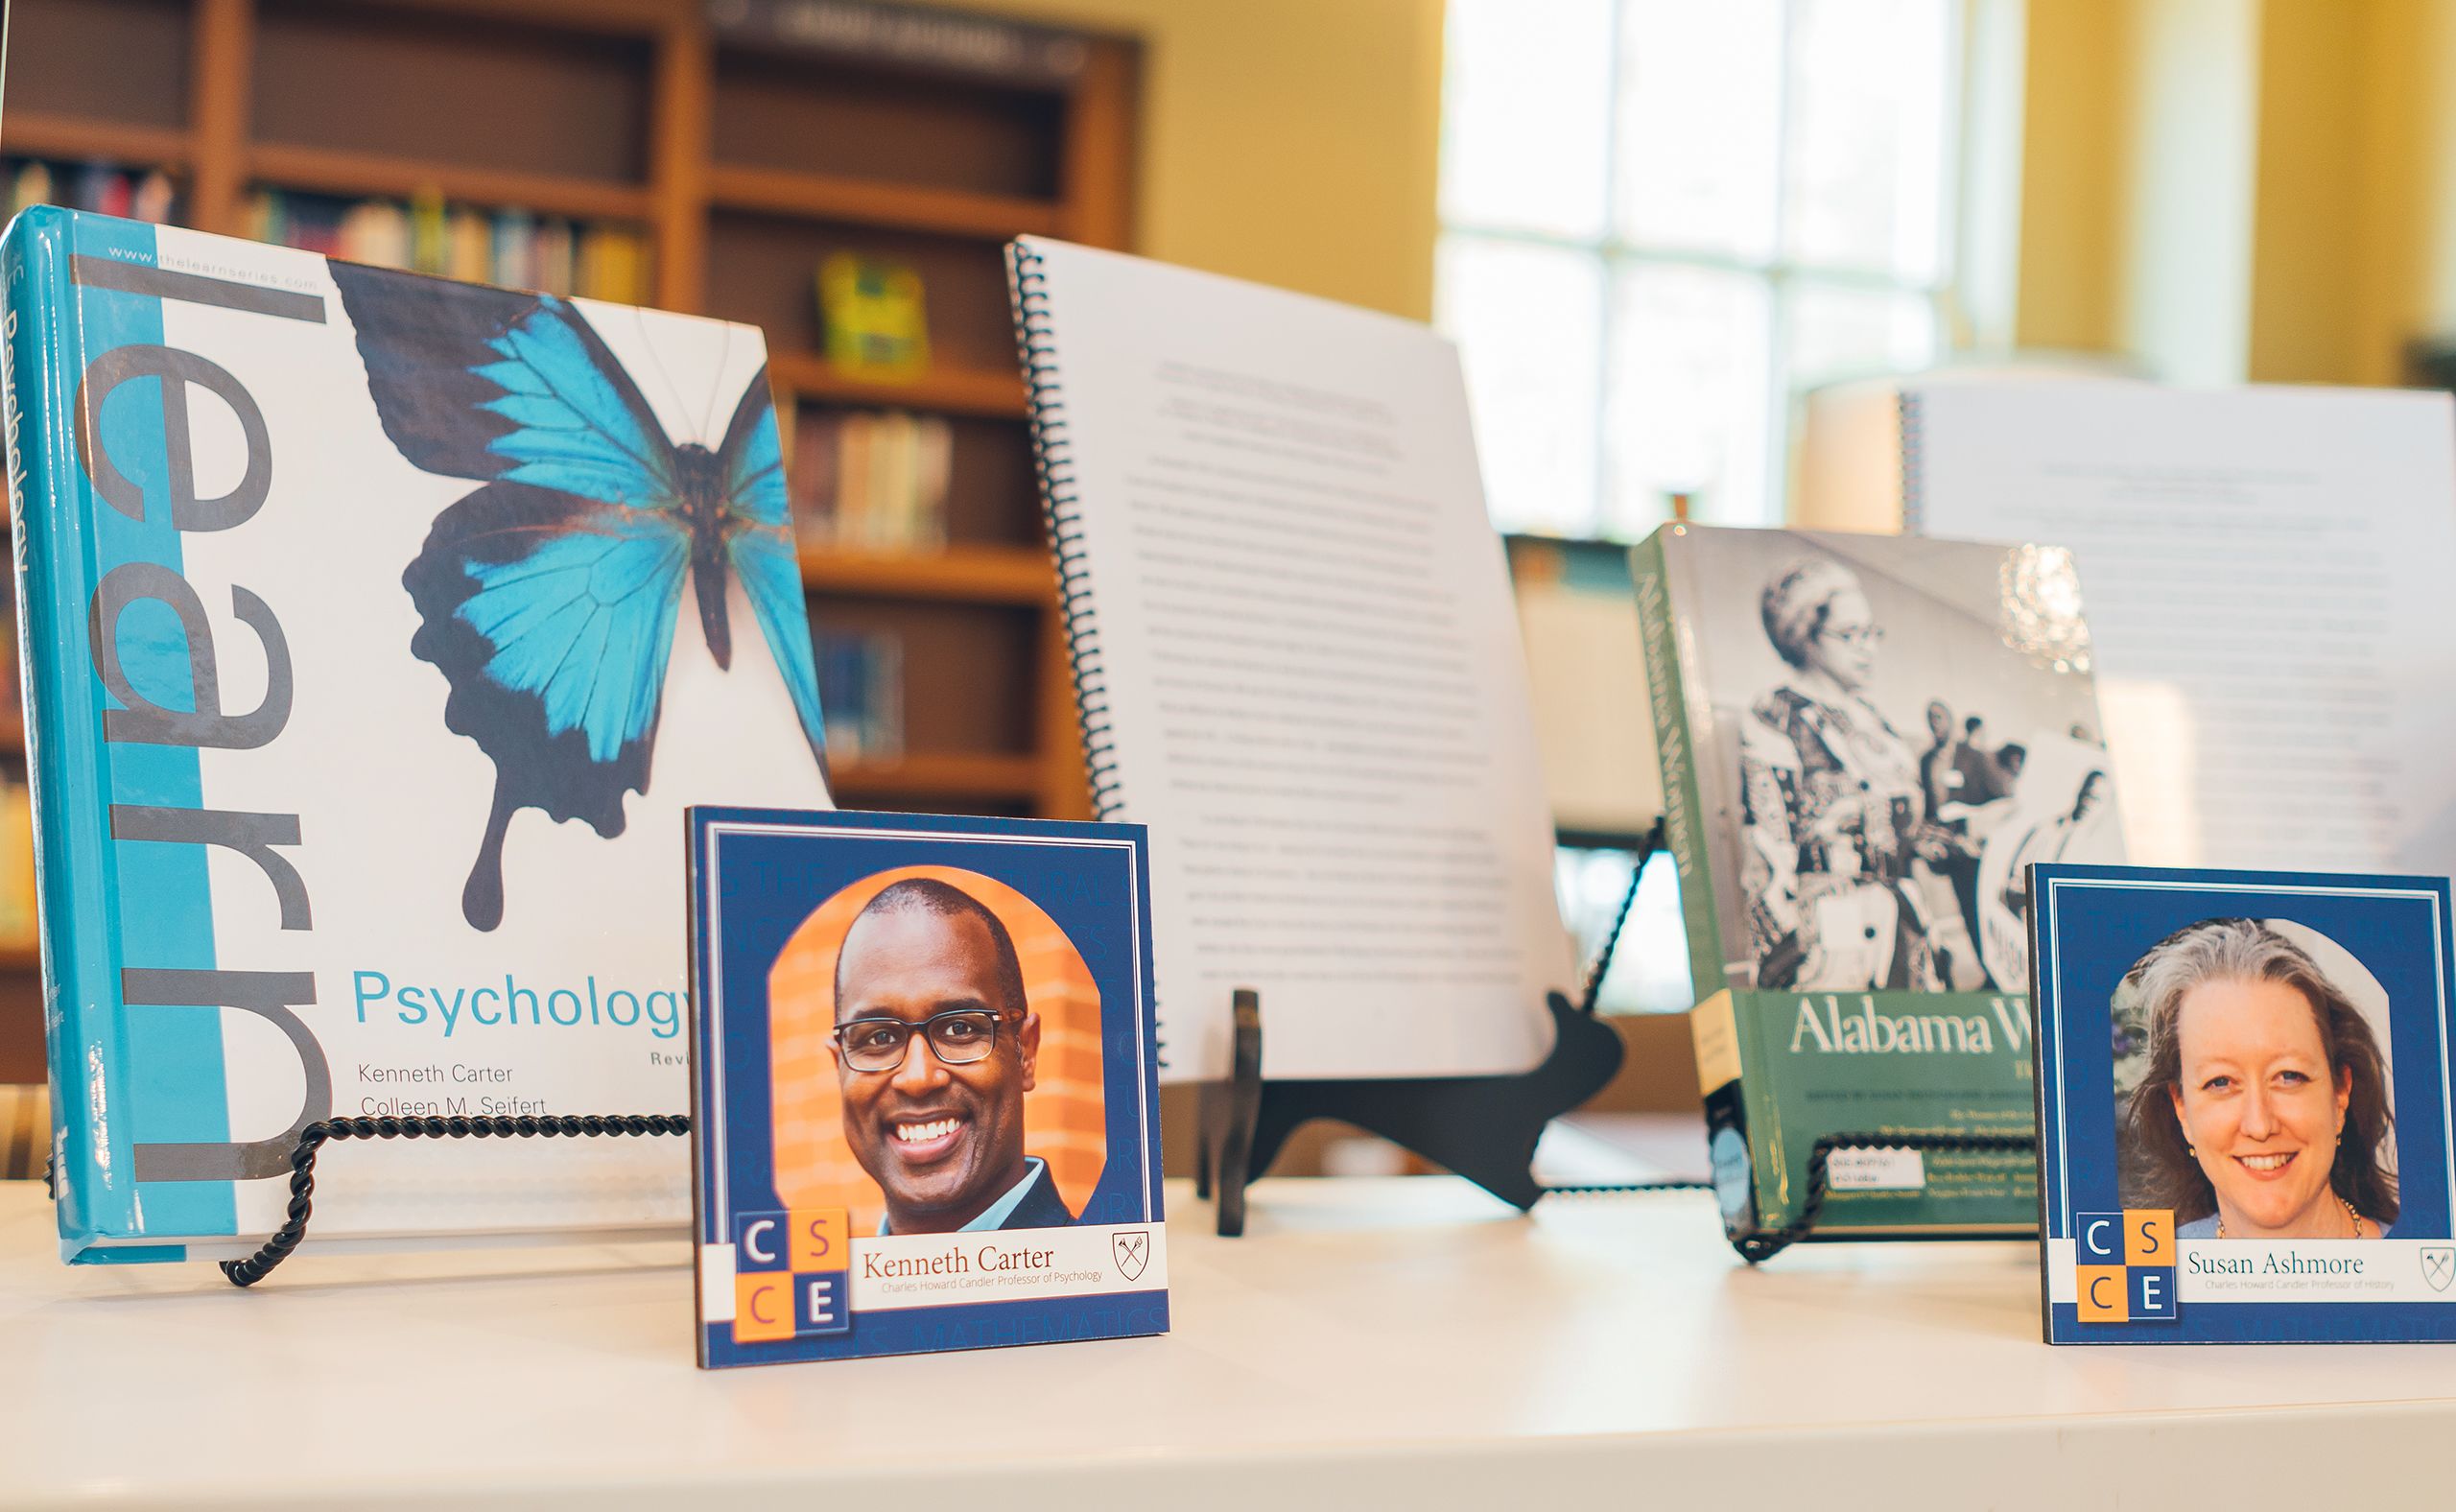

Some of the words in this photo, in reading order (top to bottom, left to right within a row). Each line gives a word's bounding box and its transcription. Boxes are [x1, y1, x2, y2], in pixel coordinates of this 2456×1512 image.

[108, 247, 319, 290] www.thelearnseries.com
[69, 253, 333, 1182] learn
[353, 970, 689, 1038] Psycholog
[1790, 996, 1994, 1052] Alabama
[358, 1063, 444, 1083] Kenneth
[452, 1063, 513, 1083] Carter
[362, 1097, 438, 1115] Colleen
[447, 1097, 472, 1115] M.
[481, 1096, 546, 1115] Seifert
[863, 1246, 969, 1279] Kenneth
[978, 1245, 1053, 1273] Carter
[2188, 1252, 2253, 1275] Susan
[2263, 1251, 2364, 1274] Ashmore
[882, 1280, 918, 1293] Charles
[920, 1278, 956, 1291] Howard
[959, 1275, 996, 1288] Candler
[998, 1273, 1041, 1287] Professor
[1042, 1272, 1053, 1284] of
[1054, 1269, 1103, 1284] Psychology
[2206, 1279, 2237, 1290] Charles
[2240, 1279, 2274, 1290] Howard
[2277, 1279, 2308, 1290] Candler
[2311, 1279, 2351, 1290] Professor
[2353, 1279, 2363, 1290] of
[2365, 1279, 2395, 1291] History
